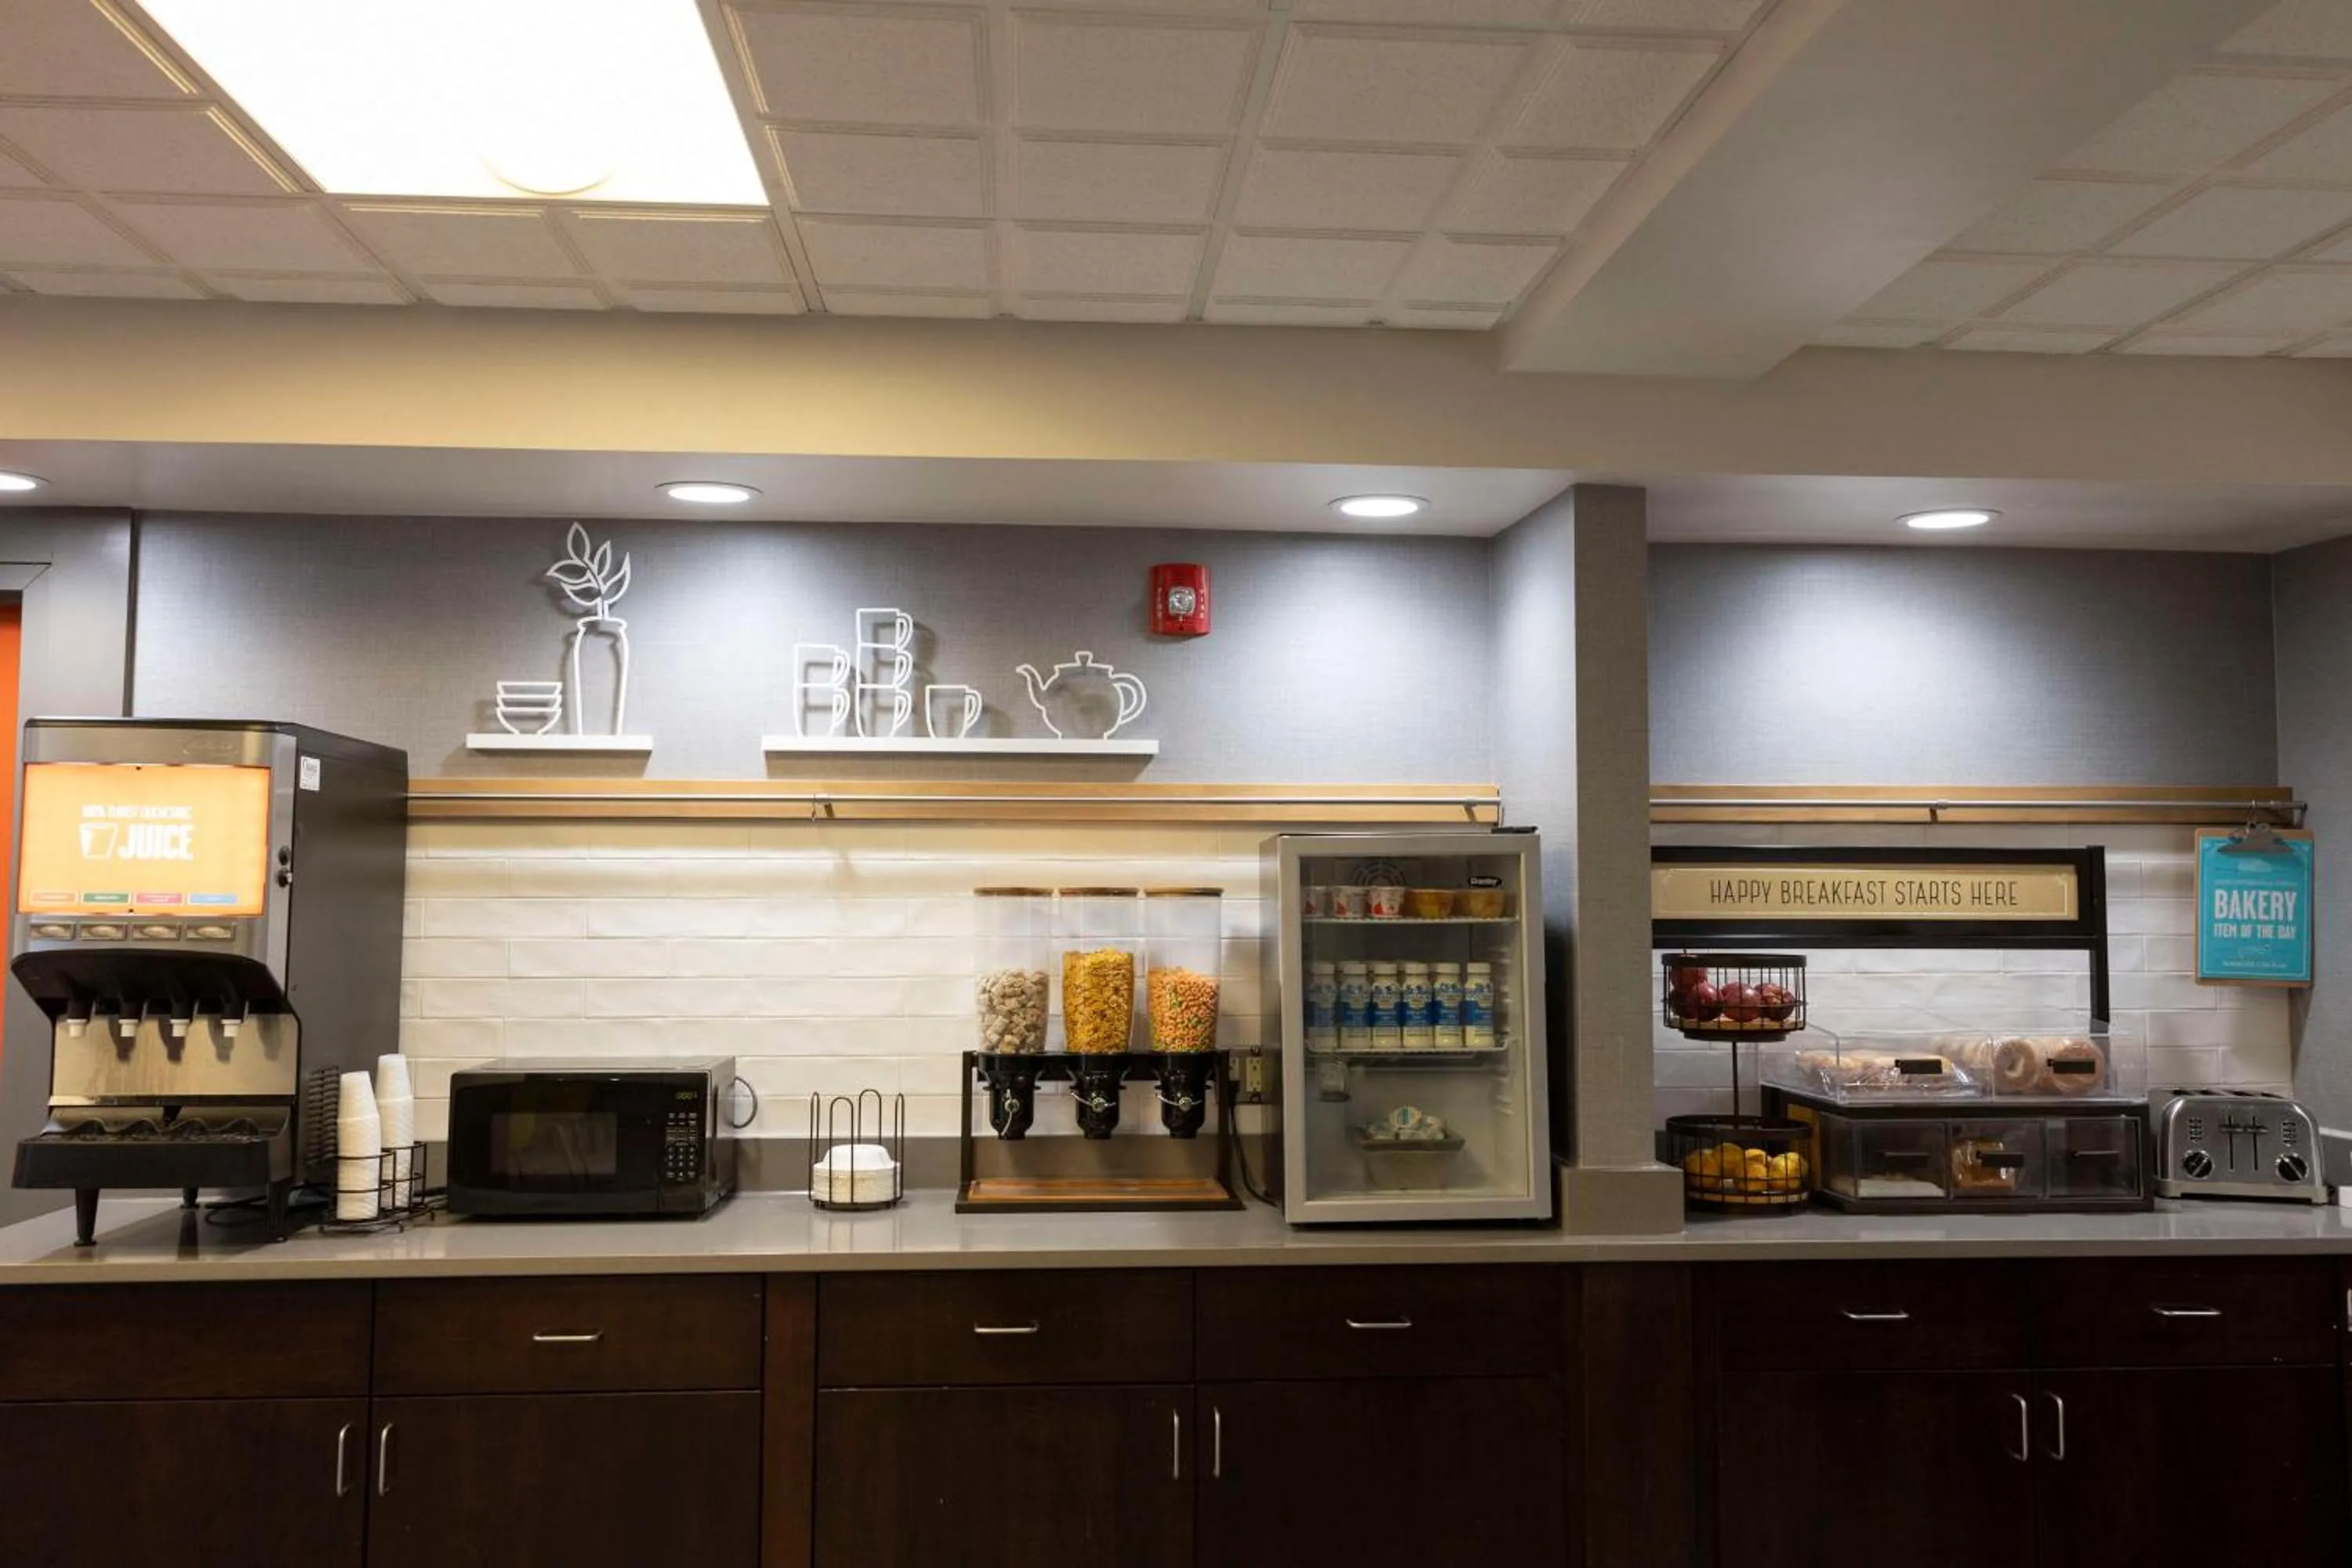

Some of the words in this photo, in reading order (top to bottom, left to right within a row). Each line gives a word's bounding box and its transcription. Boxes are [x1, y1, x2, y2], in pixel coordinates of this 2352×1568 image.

[118, 824, 194, 860] JUICE
[1710, 879, 1772, 903] HAPPY
[1780, 880, 1887, 905] BREAKFAST
[1895, 880, 1962, 906] STARTS
[1970, 880, 2019, 906] HERE
[2215, 889, 2297, 921] BAKERY
[2214, 924, 2237, 938] ITEM
[2241, 924, 2252, 938] OF
[2257, 925, 2274, 939] THE
[2278, 925, 2296, 940] DAY
